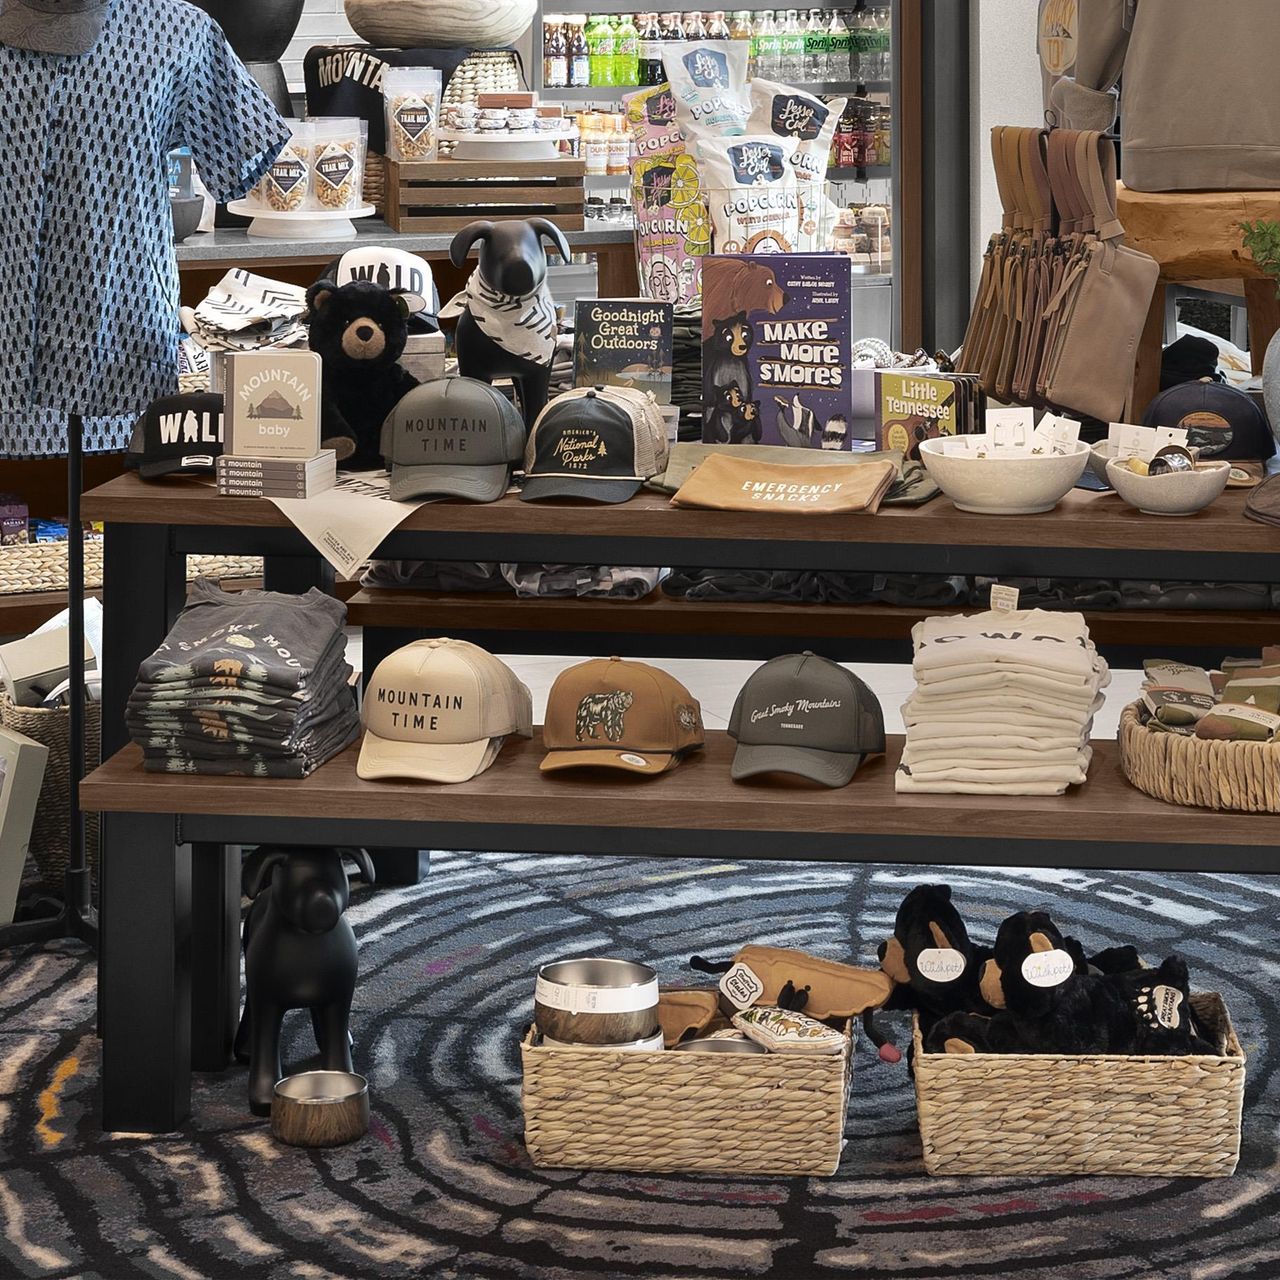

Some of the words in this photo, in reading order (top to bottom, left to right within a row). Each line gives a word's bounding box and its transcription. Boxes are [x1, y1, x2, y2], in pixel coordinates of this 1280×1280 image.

[779, 99, 814, 119] Lesser
[400, 114, 416, 123] TRAIL
[416, 115, 428, 123] MIX
[785, 118, 808, 132] Evil
[740, 145, 771, 168] Lesser
[272, 168, 288, 177] TRAIL
[289, 168, 301, 176] MIX
[321, 162, 337, 172] TRAIL
[338, 161, 350, 170] MIX
[747, 159, 770, 175] Evil
[723, 192, 798, 217] POPCORN
[591, 306, 665, 325] Goodnight
[599, 322, 640, 337] Great
[591, 336, 659, 351] Outdoors
[239, 369, 312, 402] MOUNTAIN
[901, 378, 937, 402] Little
[886, 396, 950, 421] Tennessee
[258, 423, 291, 438] baby
[405, 417, 488, 433] MOUNTAIN
[421, 438, 467, 453] TIME
[553, 435, 598, 457] National
[228, 461, 262, 469] mountain
[562, 452, 596, 466] Parks
[229, 470, 263, 478] mountain
[229, 478, 263, 487] mountain
[741, 480, 842, 494] EMERGENCY
[229, 488, 263, 496] mountain
[751, 492, 822, 503] SNACKS
[178, 623, 260, 651] SMOKY
[377, 686, 463, 711] MOUNTAIN
[769, 702, 795, 717] Smoky
[795, 698, 841, 713] Mountains
[391, 711, 439, 732] TIME
